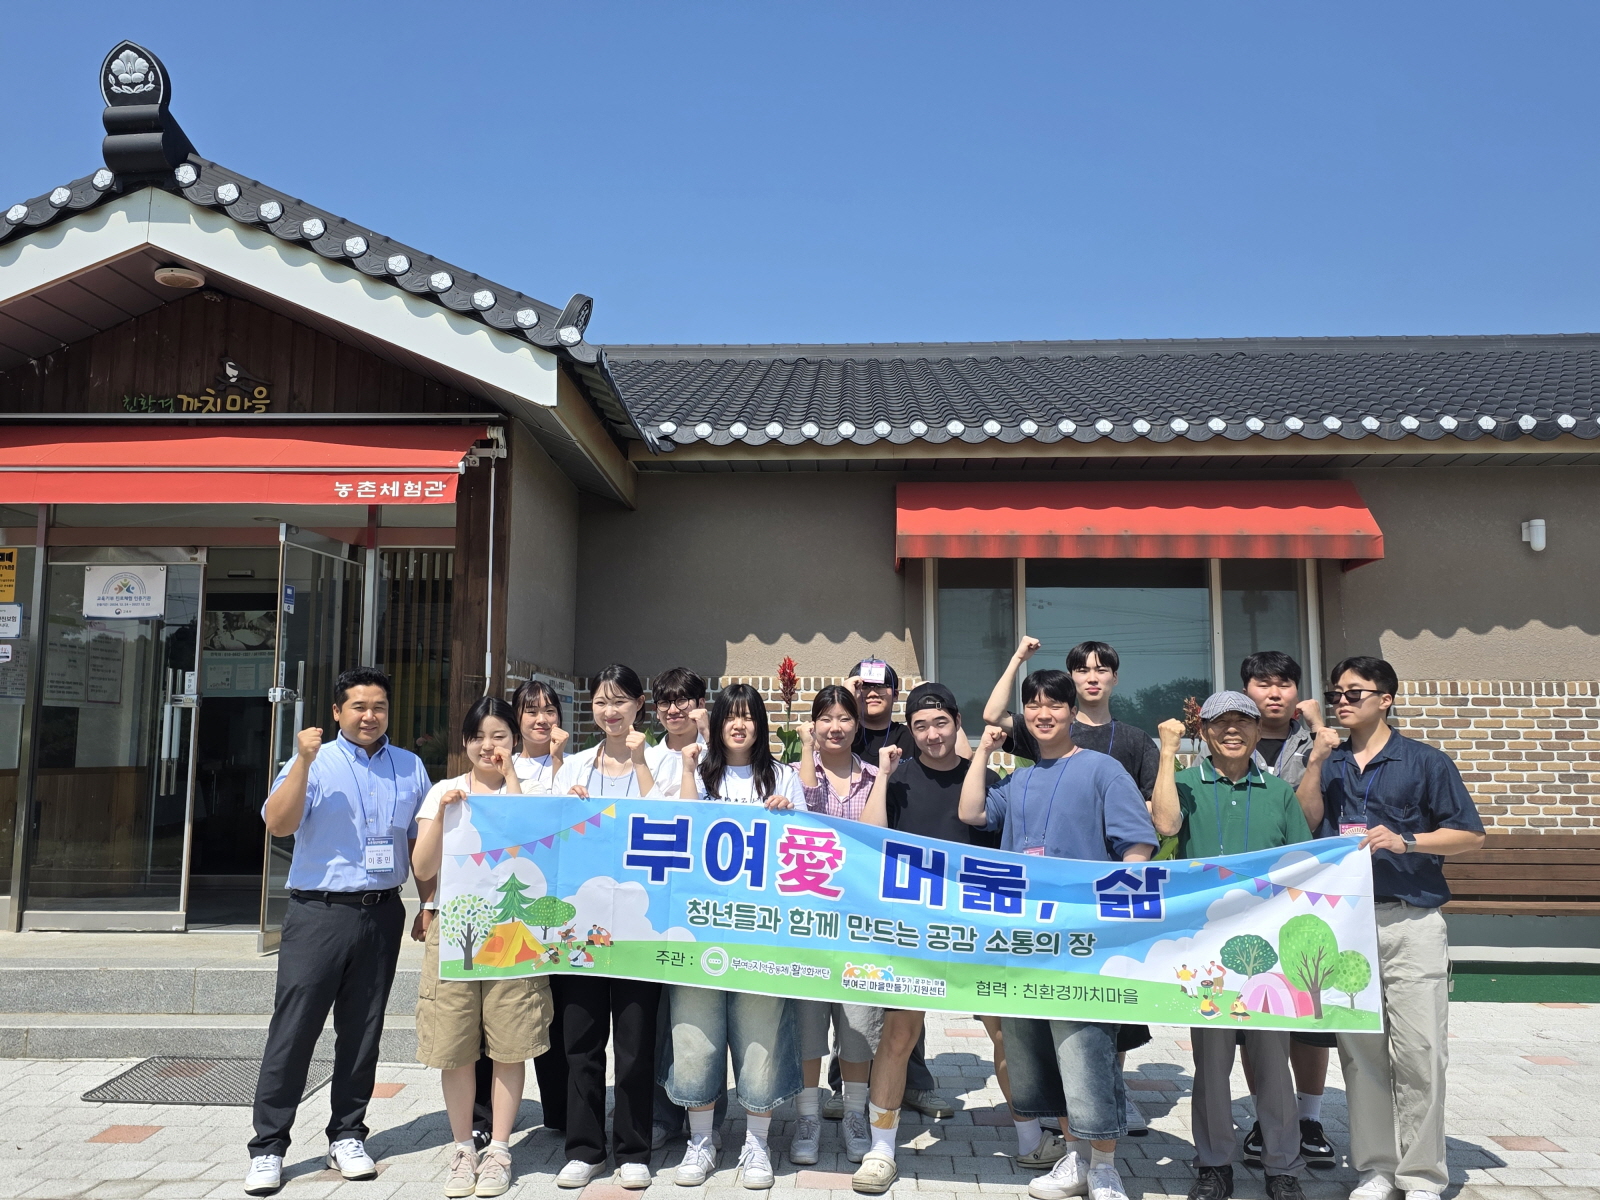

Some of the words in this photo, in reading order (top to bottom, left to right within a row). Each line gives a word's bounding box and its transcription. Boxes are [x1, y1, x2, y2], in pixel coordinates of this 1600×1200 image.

[122, 393, 175, 413] 친환경
[177, 386, 271, 414] 까치마을
[333, 480, 447, 498] 농촌체험관
[624, 815, 844, 899] 부여愛
[881, 840, 1059, 921] 머묾,
[1095, 866, 1169, 920] 삶
[687, 899, 782, 933] 청년들과
[789, 908, 840, 939] 함께
[847, 914, 919, 947] 만드는
[927, 924, 978, 953] 공감
[985, 930, 1061, 956] 소통의
[1068, 932, 1097, 957] 장
[655, 950, 685, 967] 주관
[791, 963, 830, 979] 활성화재단
[842, 979, 866, 989] 부여군
[869, 981, 910, 993] 마을만들기
[913, 985, 946, 996] 지원센터
[976, 980, 1008, 998] 협력
[1022, 982, 1140, 1005] 친환경까치마을
